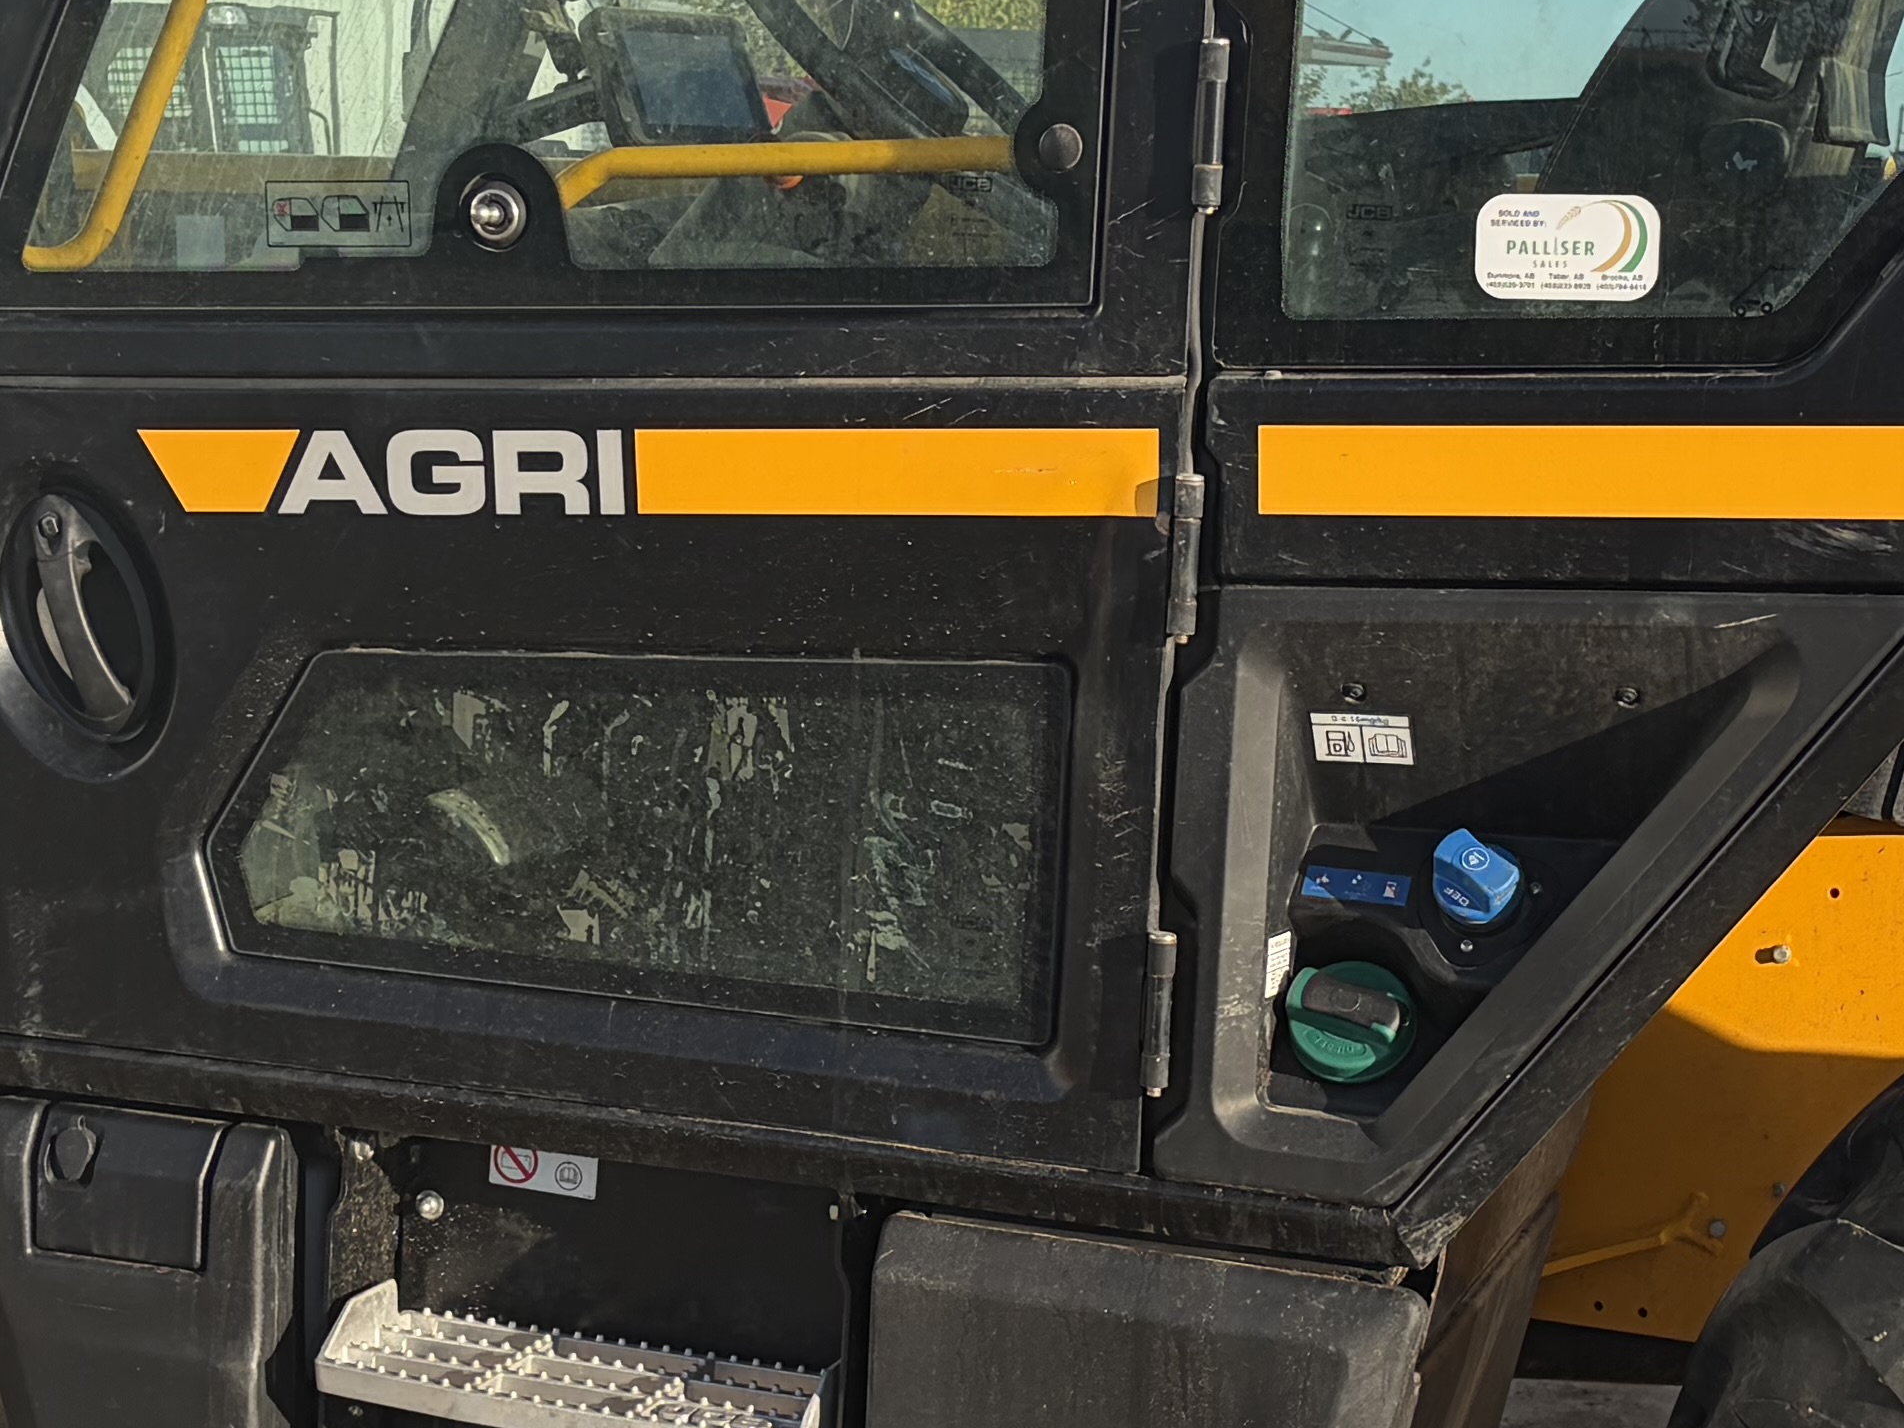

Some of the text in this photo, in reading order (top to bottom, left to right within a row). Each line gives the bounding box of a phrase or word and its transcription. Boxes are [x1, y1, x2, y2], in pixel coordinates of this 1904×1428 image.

[950, 177, 991, 190] JCB
[1347, 205, 1392, 219] JCB
[1507, 236, 1594, 255] PALLISER
[1533, 260, 1567, 268] SALES
[278, 429, 626, 515] AGRI
[1443, 886, 1469, 907] DEF
